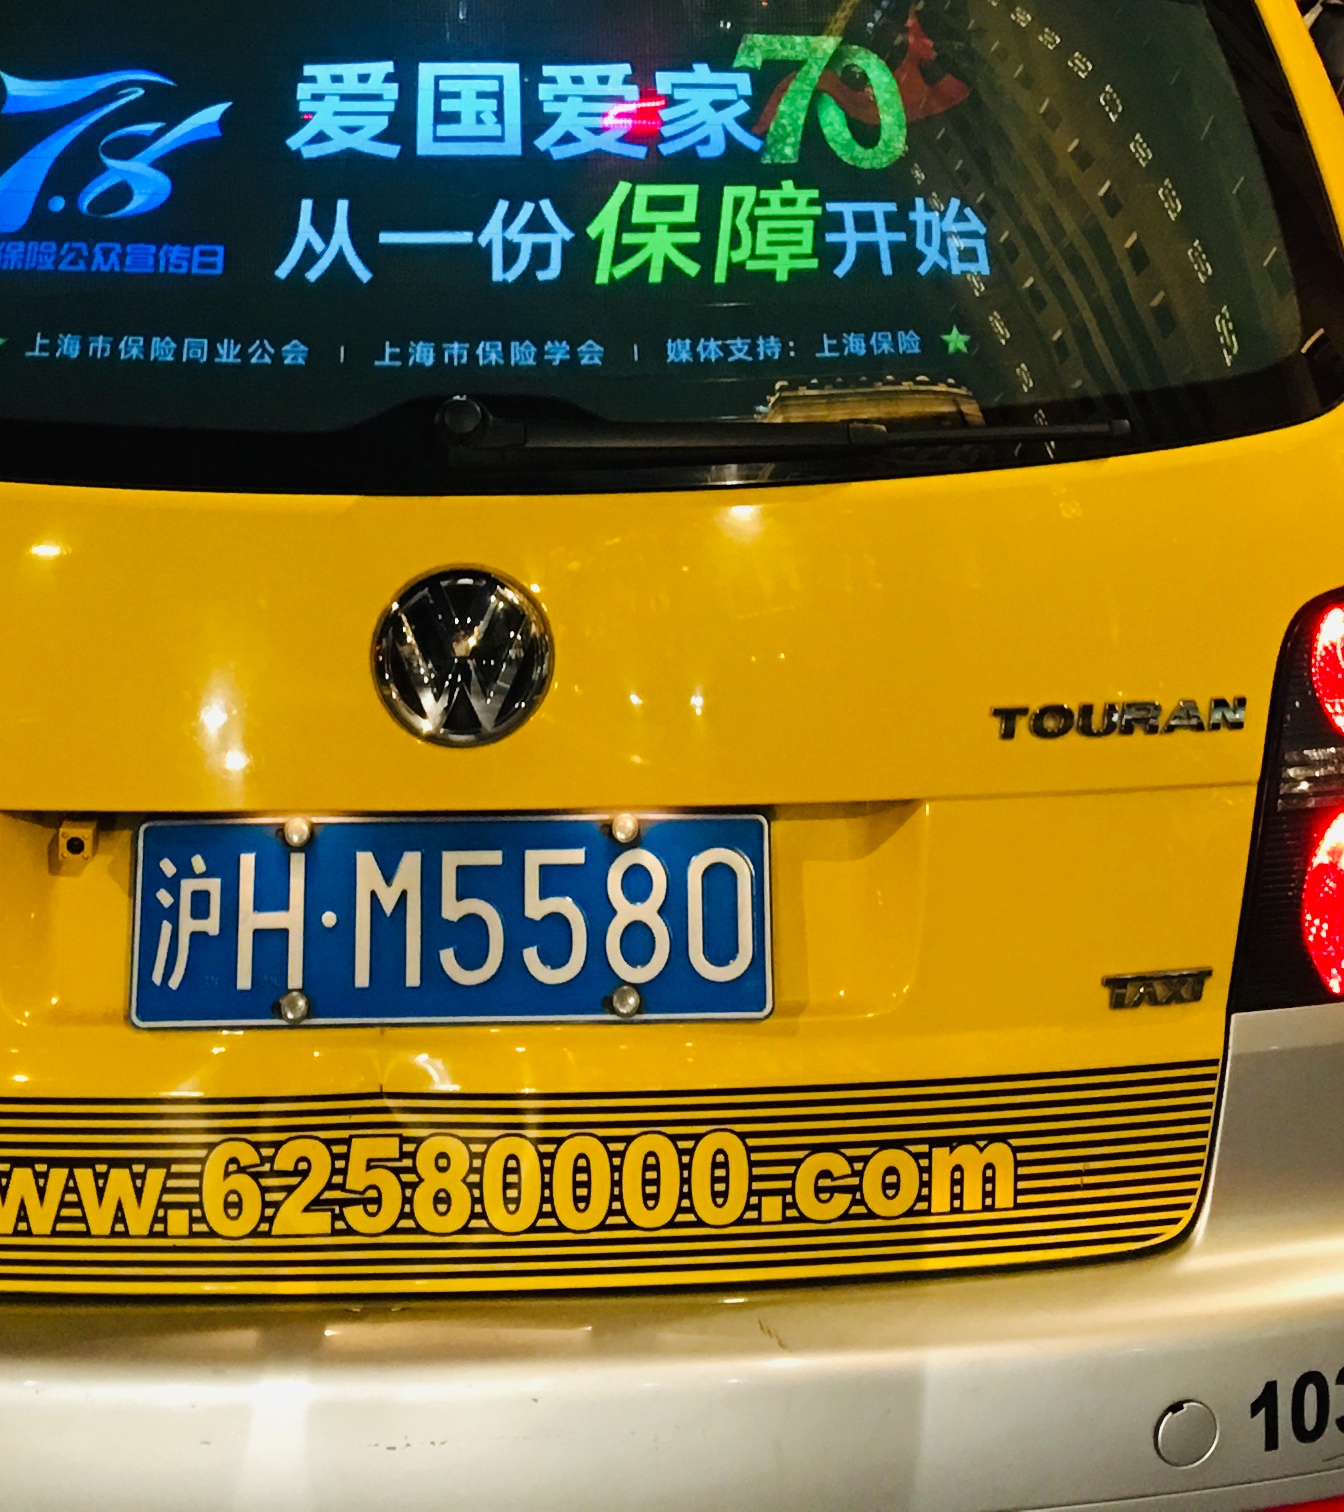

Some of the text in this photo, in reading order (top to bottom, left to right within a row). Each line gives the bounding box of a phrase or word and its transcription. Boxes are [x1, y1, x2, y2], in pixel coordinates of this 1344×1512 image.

[272, 179, 991, 284] 从一份保障开始
[24, 332, 310, 367] 上海市保险同业公会
[374, 338, 606, 367] 上海市保险学会
[991, 696, 1247, 741] TOURAN
[151, 847, 755, 991] 沪H·M5580
[1101, 966, 1214, 1011] TAXI
